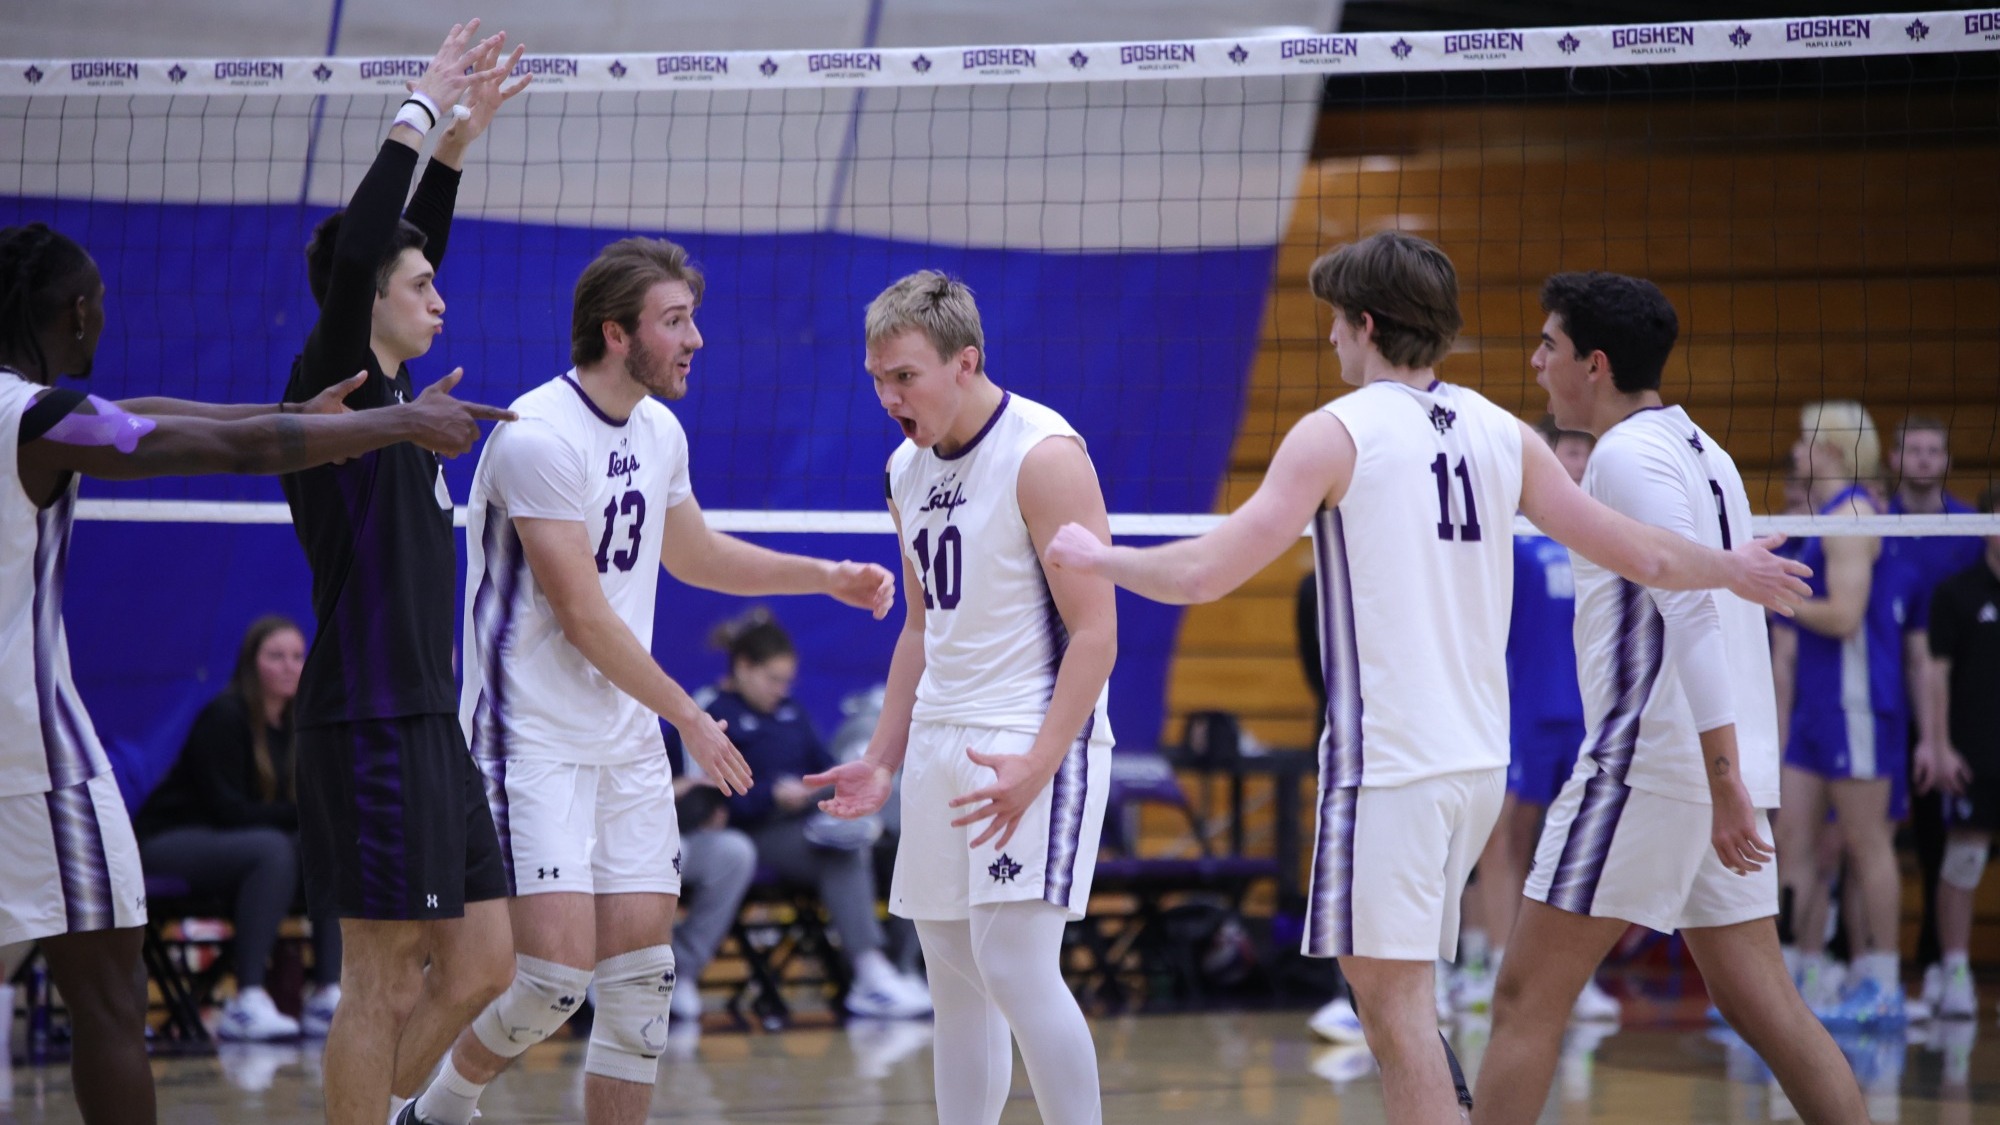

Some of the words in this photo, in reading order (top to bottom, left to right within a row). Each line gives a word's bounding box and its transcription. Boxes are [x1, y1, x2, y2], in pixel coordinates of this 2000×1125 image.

[1612, 27, 1694, 49] GOSHEN
[1786, 20, 1870, 42] GOSHEN
[1281, 38, 1357, 59] GOSHEN
[1444, 33, 1523, 54] GOSHEN
[808, 53, 881, 72] GOSHEN
[963, 49, 1036, 69] GOSHEN
[1121, 44, 1195, 65] GOSHEN
[71, 62, 138, 80] GOSHEN
[215, 62, 283, 80] GOSHEN
[657, 56, 728, 75] GOSHEN
[1430, 452, 1482, 542] 11
[594, 490, 646, 573] 13
[912, 525, 962, 610] 10
